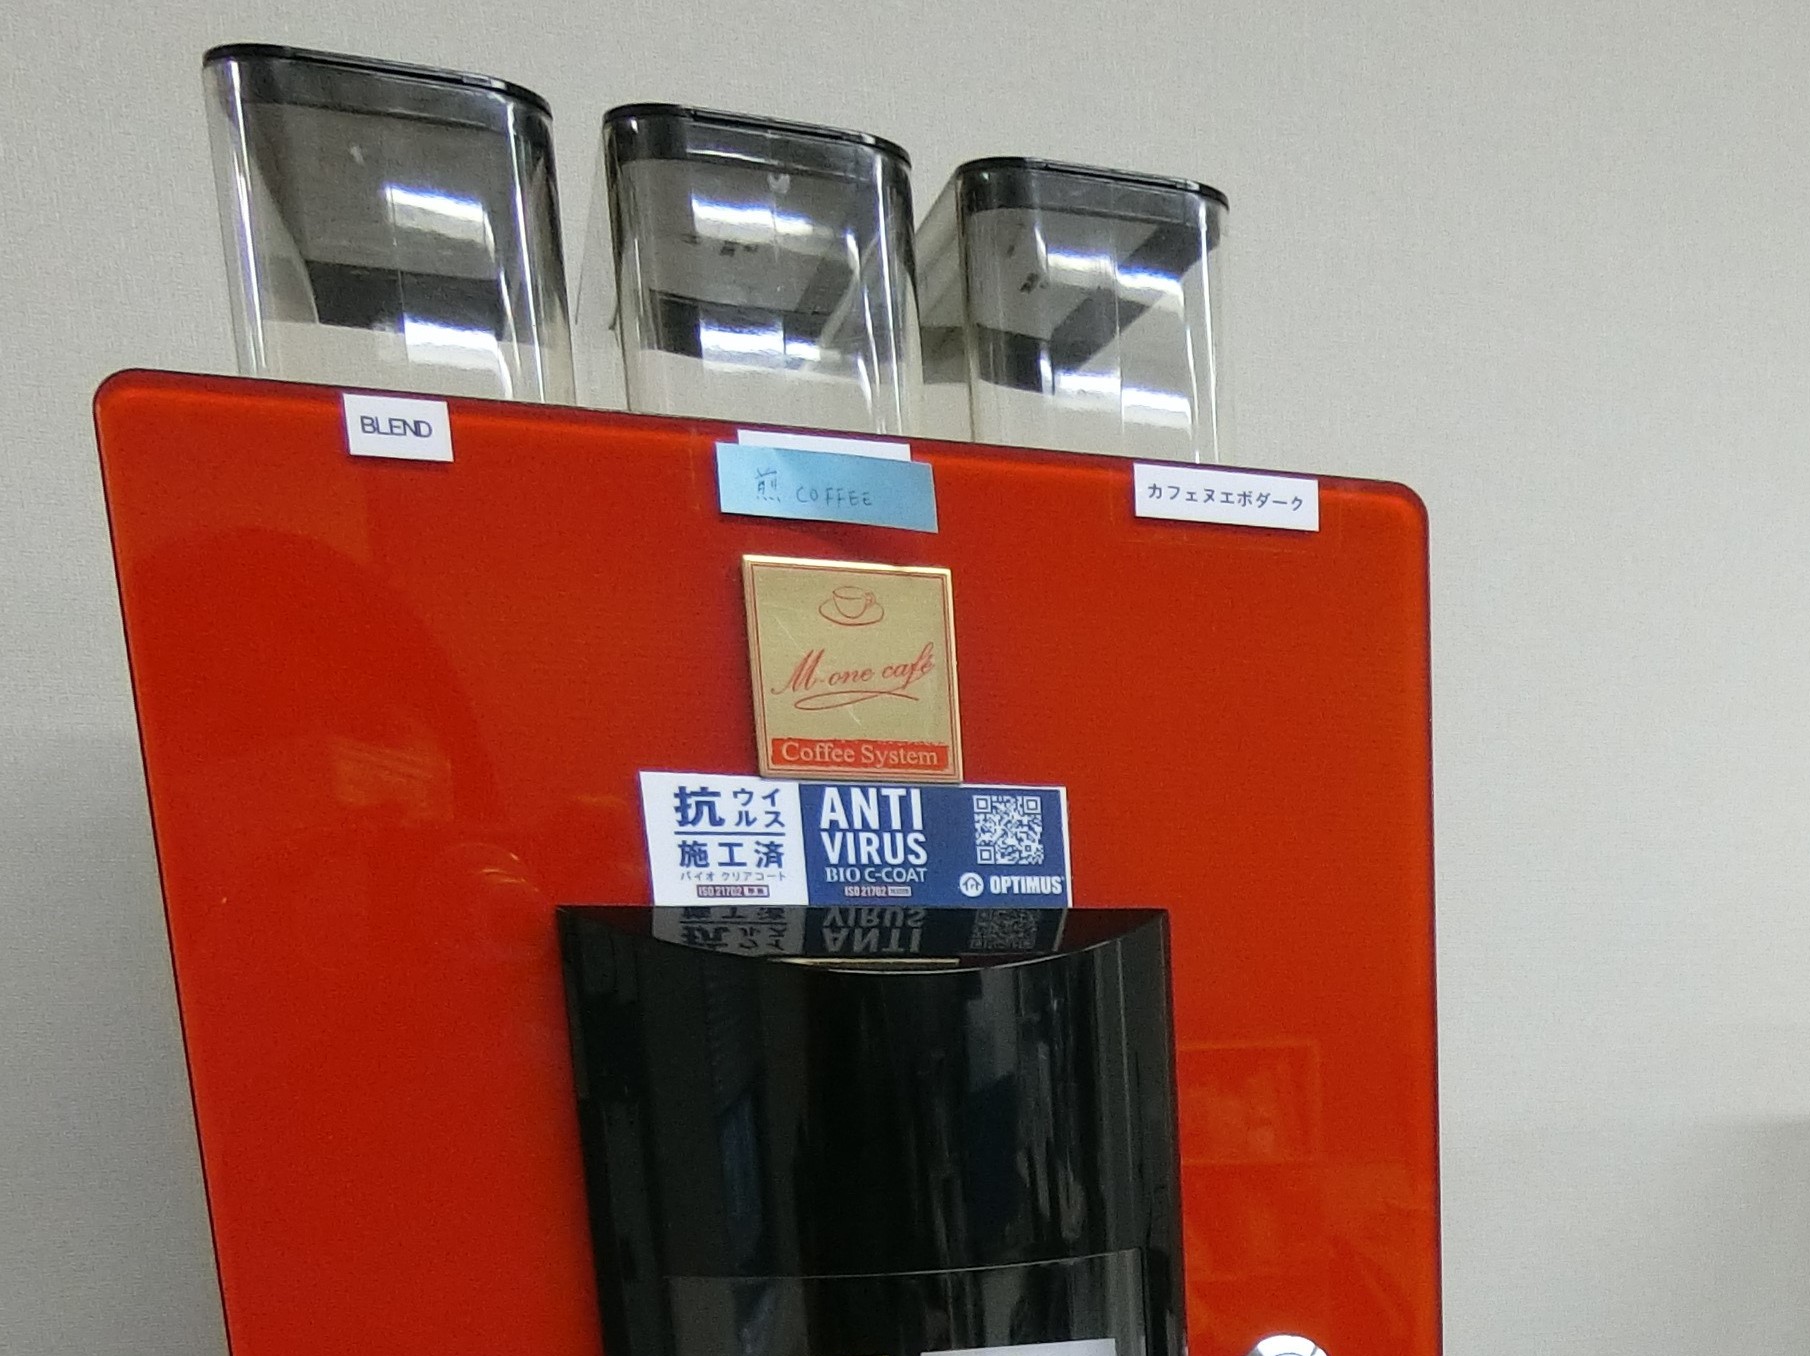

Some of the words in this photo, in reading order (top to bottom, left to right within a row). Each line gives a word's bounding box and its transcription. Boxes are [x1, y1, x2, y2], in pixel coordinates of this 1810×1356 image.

[360, 415, 433, 438] BLEND
[796, 486, 873, 508] COFFEE
[1148, 483, 1303, 512] カフェヌエボダーク
[781, 741, 855, 763] Coffee
[861, 743, 938, 768] System
[673, 785, 724, 827] 抗
[819, 786, 924, 830] ANTI
[678, 840, 786, 869] 施工済
[821, 831, 928, 866] VIRUS
[825, 867, 861, 883] BIO
[864, 867, 928, 883] C-COAT
[989, 875, 1063, 895] OPTIMUS
